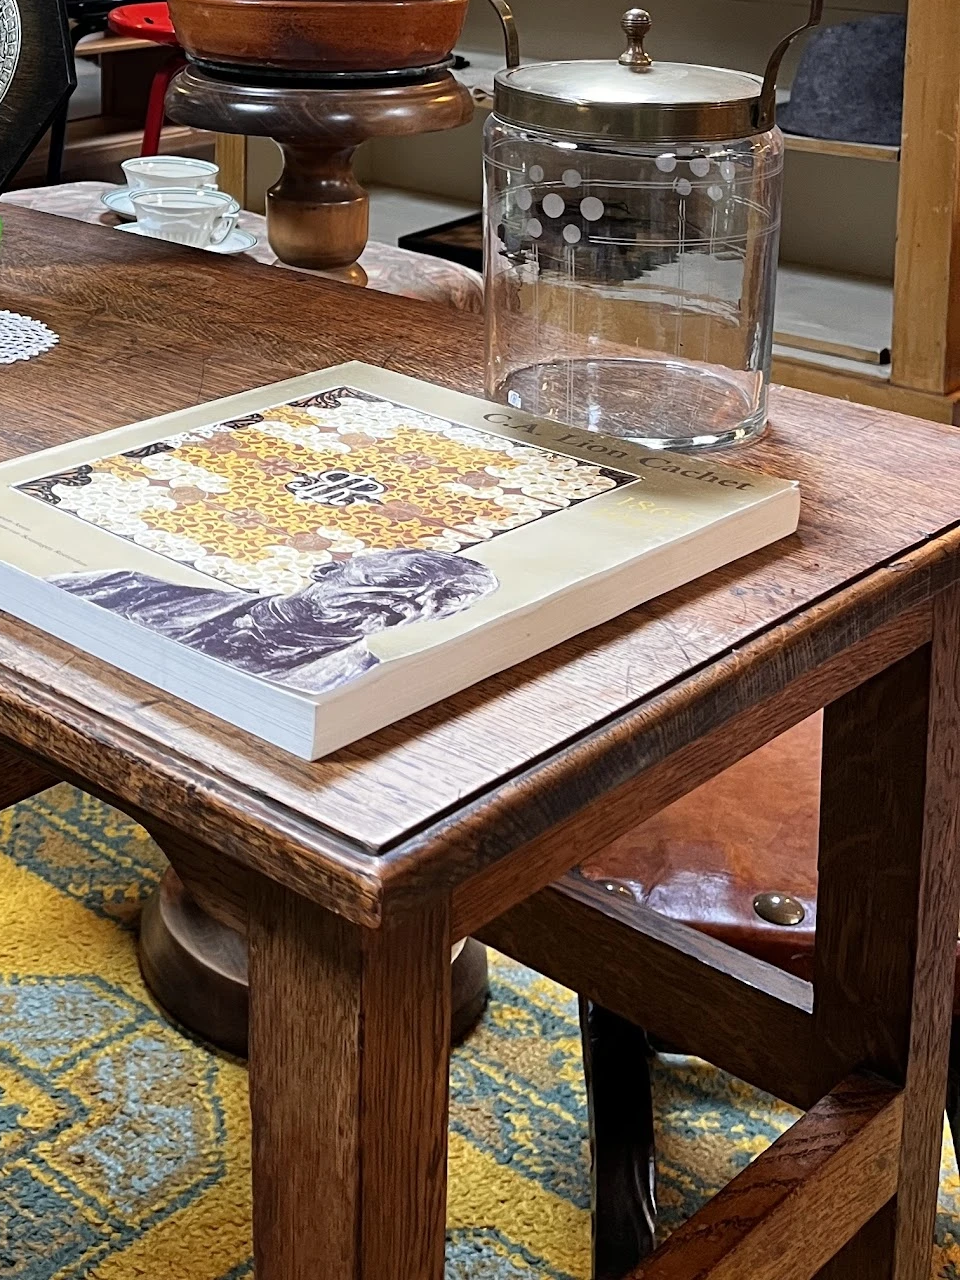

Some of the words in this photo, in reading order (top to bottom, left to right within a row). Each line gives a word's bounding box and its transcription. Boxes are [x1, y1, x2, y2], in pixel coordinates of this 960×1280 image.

[483, 412, 541, 437] C.A.
[555, 433, 627, 460] Lion
[639, 456, 756, 492] Cachet
